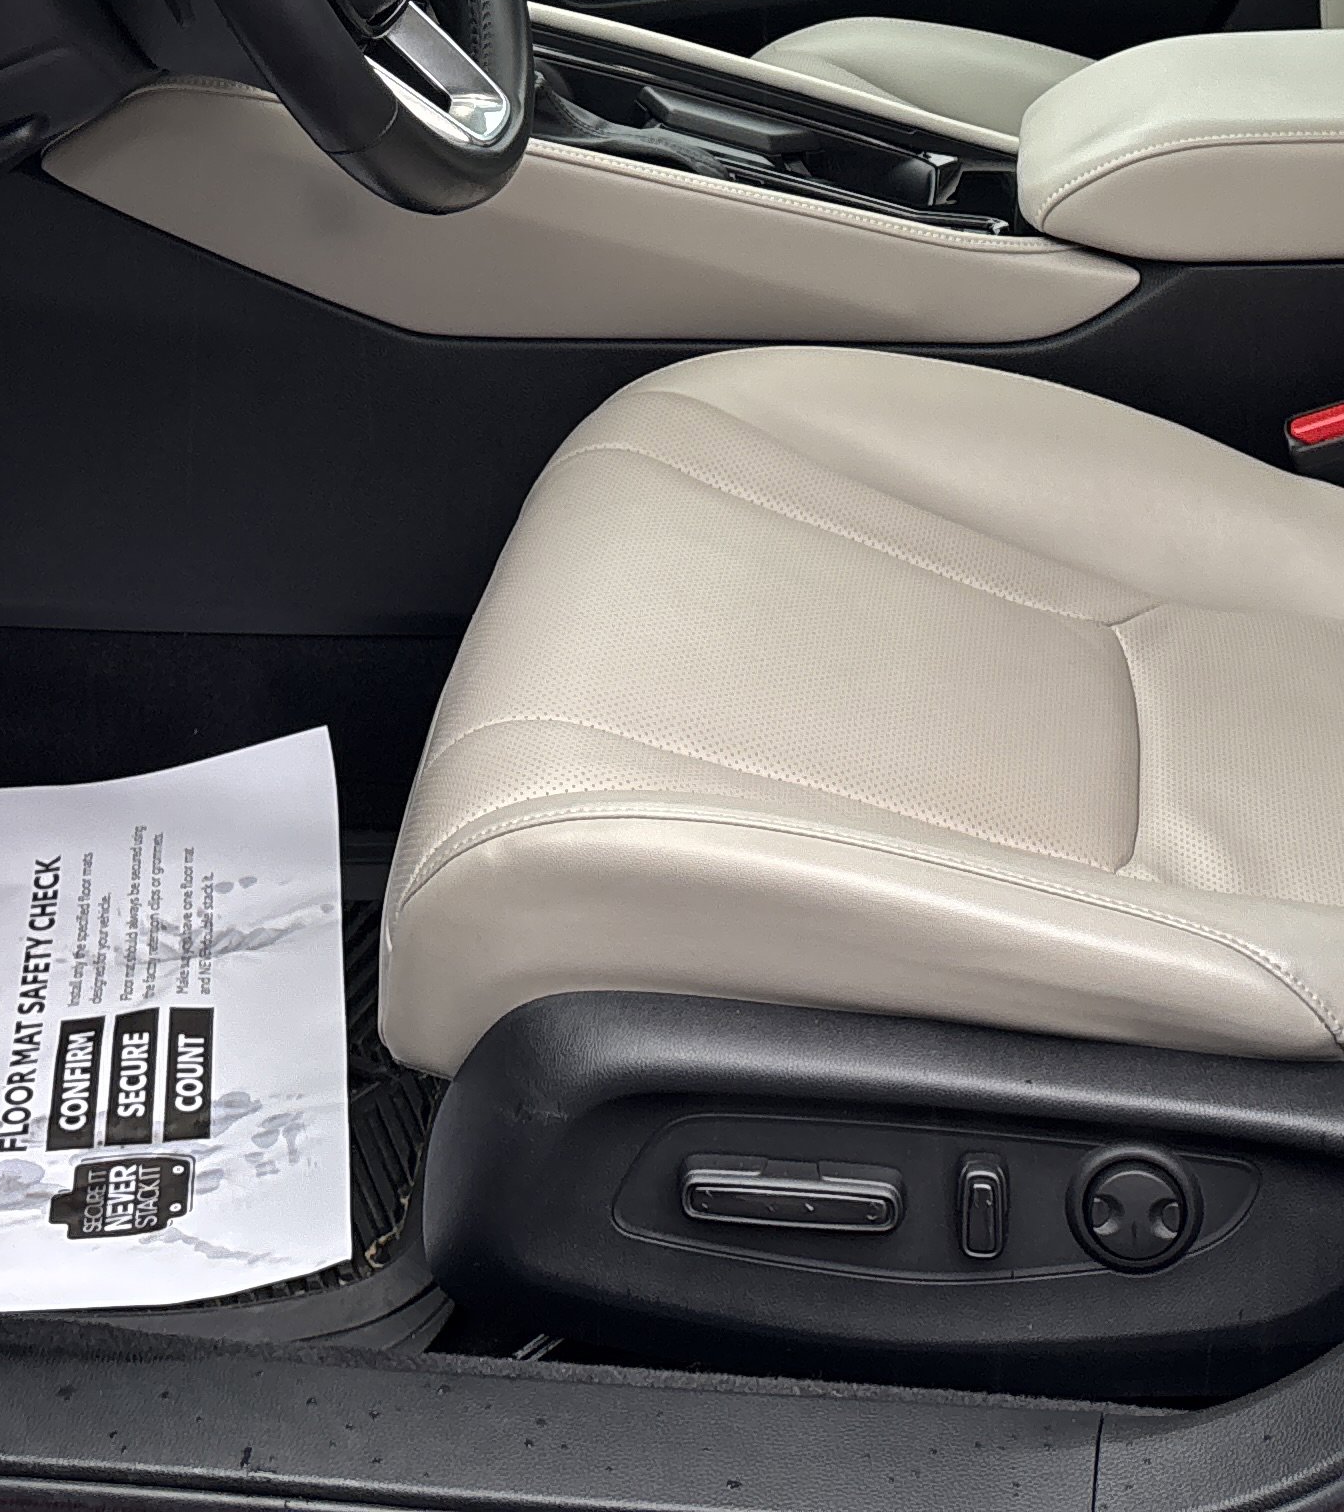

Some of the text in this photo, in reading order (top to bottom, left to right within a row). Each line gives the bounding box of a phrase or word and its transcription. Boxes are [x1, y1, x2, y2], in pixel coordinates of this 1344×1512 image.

[28, 854, 61, 930] CHECK
[17, 934, 52, 1014] SAFETY
[10, 1021, 43, 1066] MAT
[59, 1031, 94, 1130] CONFIRM
[117, 1032, 149, 1117] SECURE
[174, 1033, 204, 1111] COUNT
[82, 1169, 106, 1233] SECURE IT
[104, 1164, 136, 1231] NEVER
[134, 1164, 160, 1228] STACK IT
